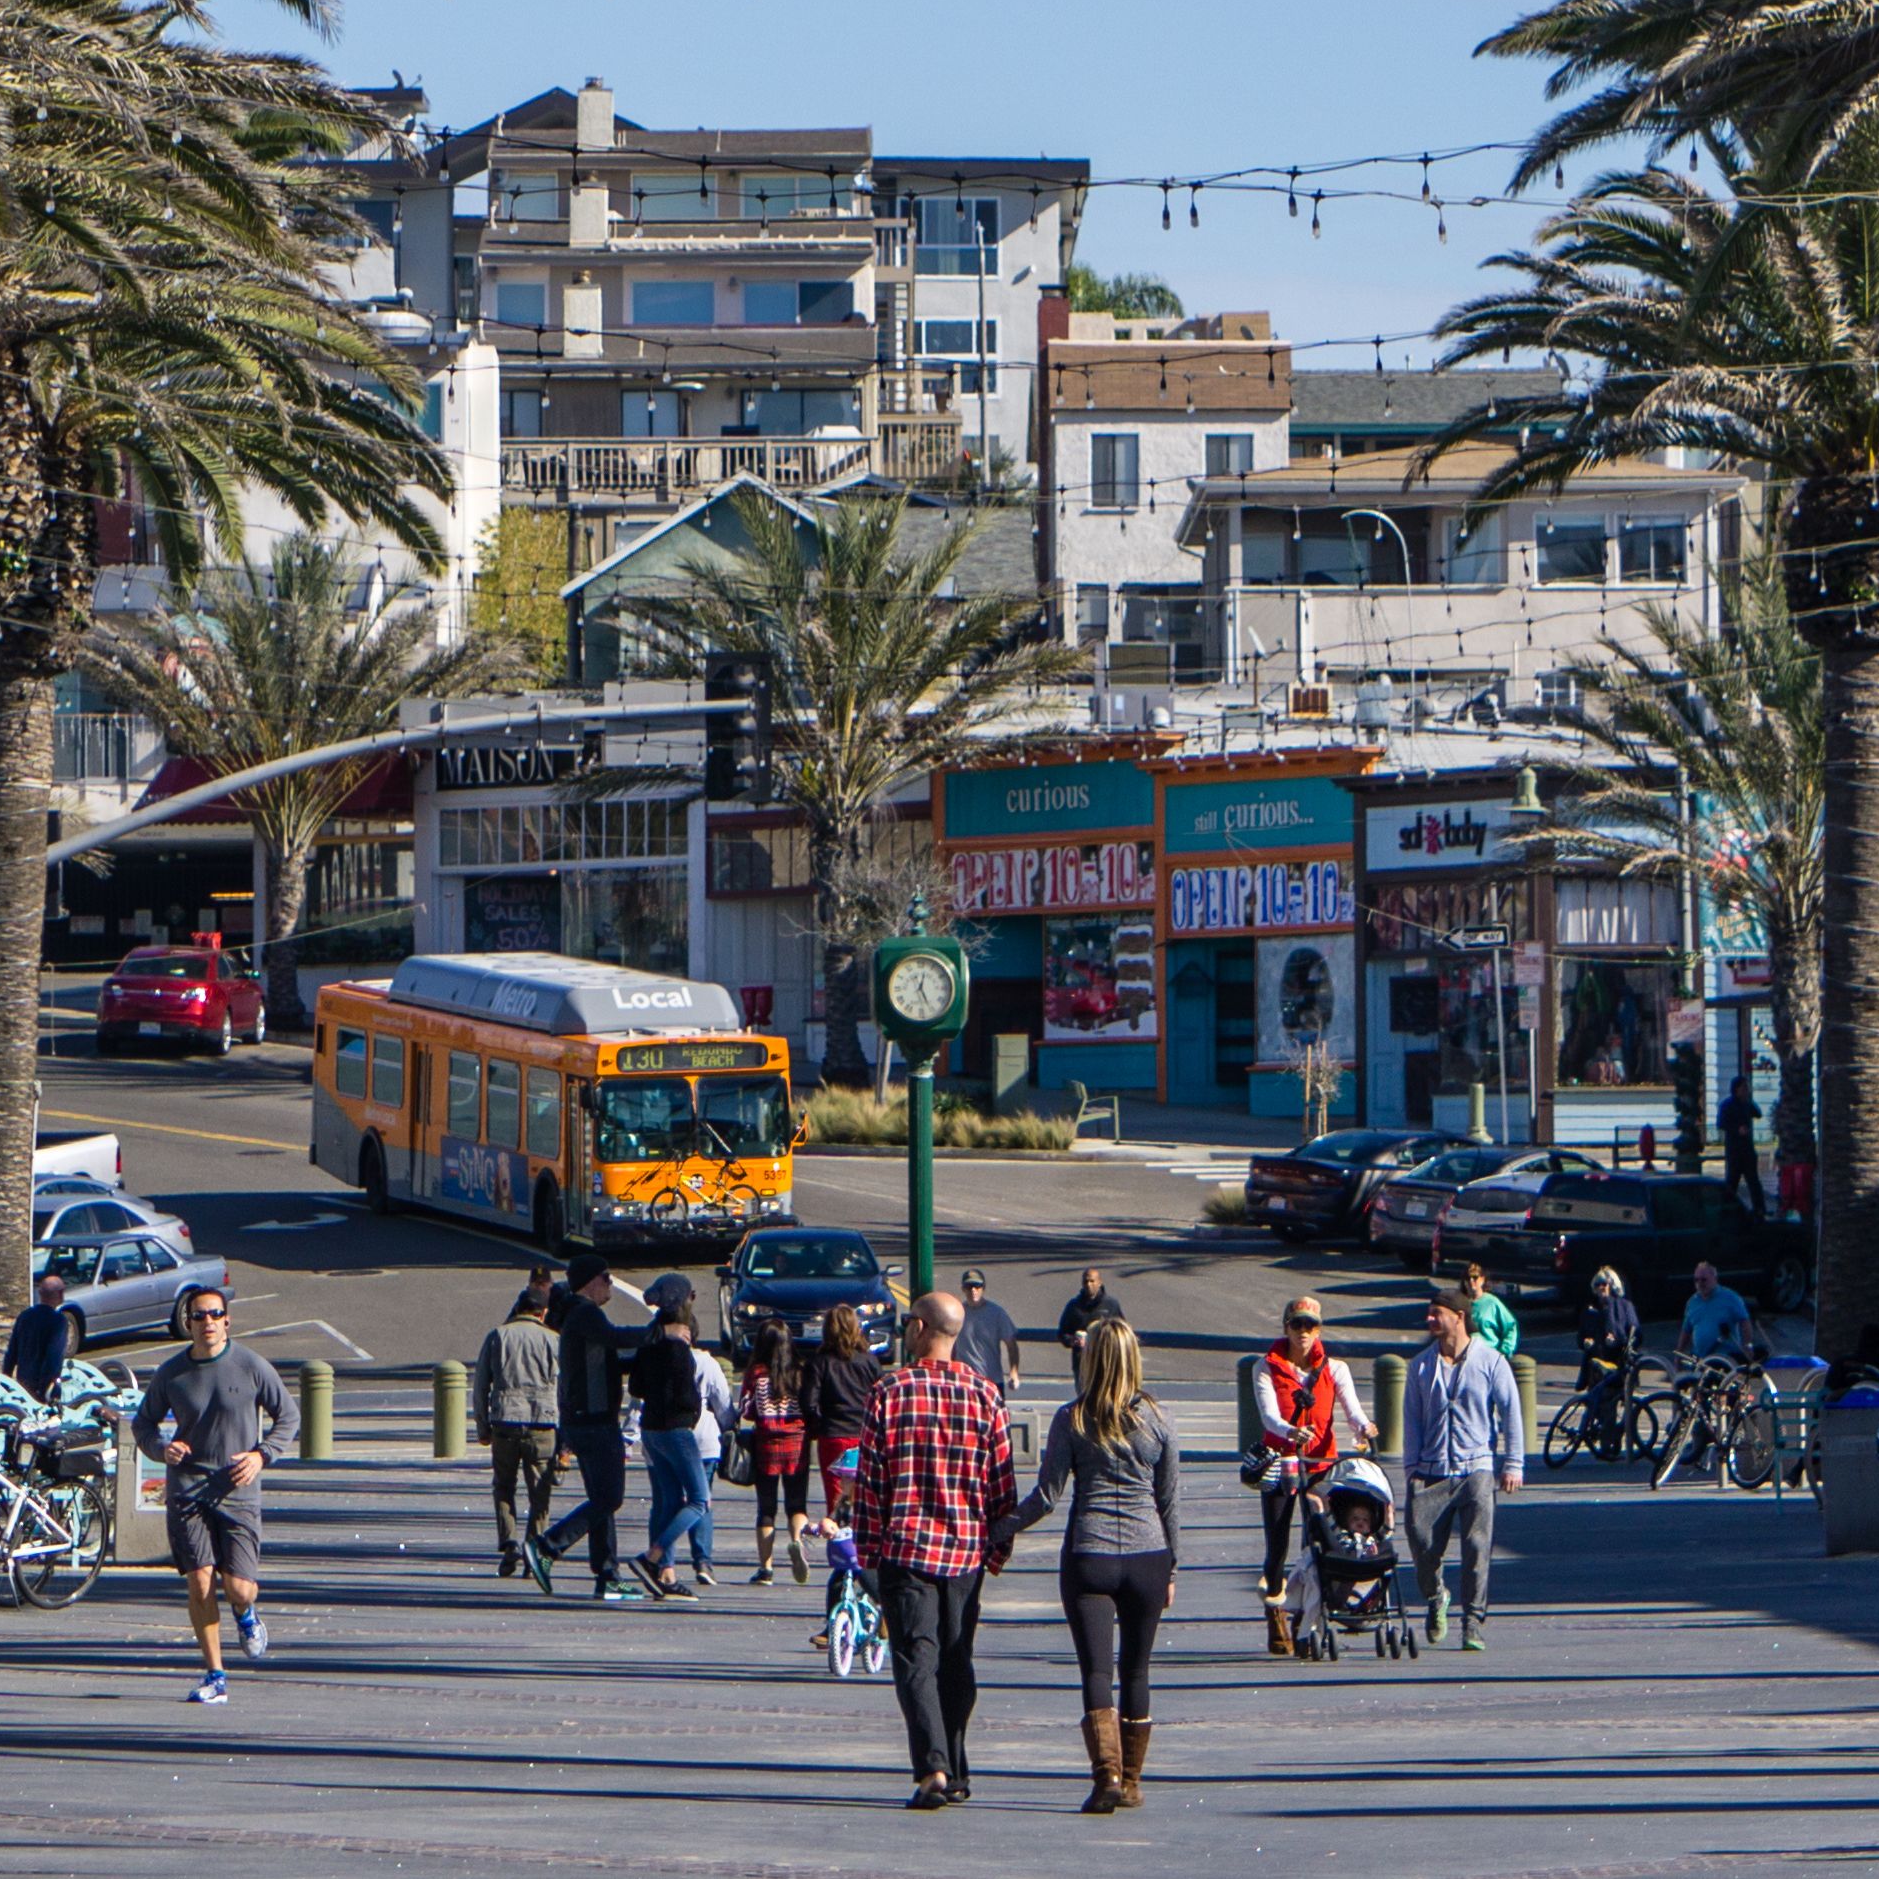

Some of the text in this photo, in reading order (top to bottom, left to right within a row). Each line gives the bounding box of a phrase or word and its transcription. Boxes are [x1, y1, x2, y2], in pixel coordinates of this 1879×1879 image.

[441, 748, 555, 783] MAISON
[1006, 780, 1091, 813] curious
[1194, 811, 1218, 833] still
[484, 904, 542, 922] SALES
[497, 921, 550, 950] 50%
[490, 976, 539, 1018] Metro
[612, 985, 693, 1010] Local
[623, 1047, 664, 1070] 130
[691, 1054, 735, 1068] BEACH
[764, 1169, 787, 1181] 5357
